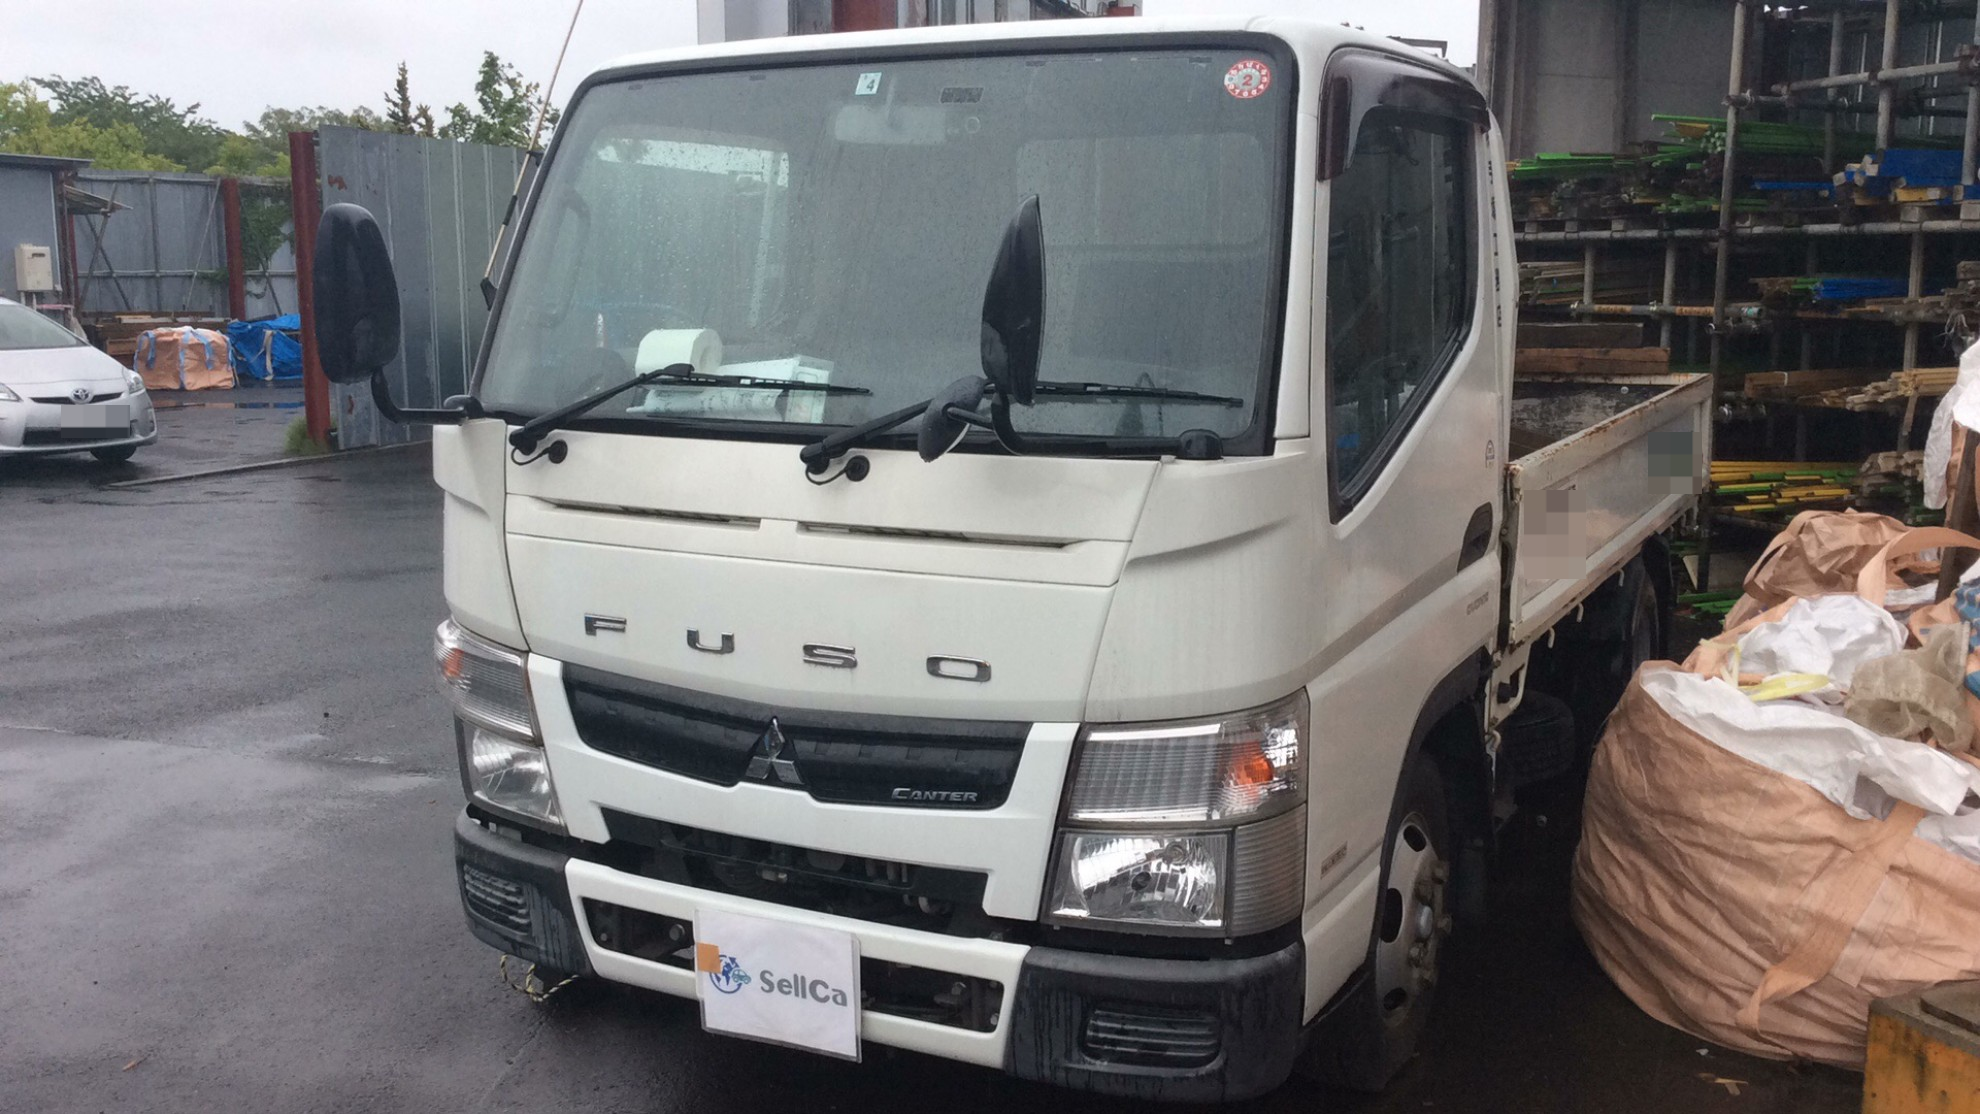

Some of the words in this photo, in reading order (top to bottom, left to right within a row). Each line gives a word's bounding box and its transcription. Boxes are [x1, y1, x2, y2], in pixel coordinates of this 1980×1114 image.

[866, 79, 876, 92] 4
[1242, 74, 1253, 86] 2
[584, 612, 992, 682] FUSO
[891, 787, 978, 802] CANTER
[759, 969, 848, 1007] SellCa
